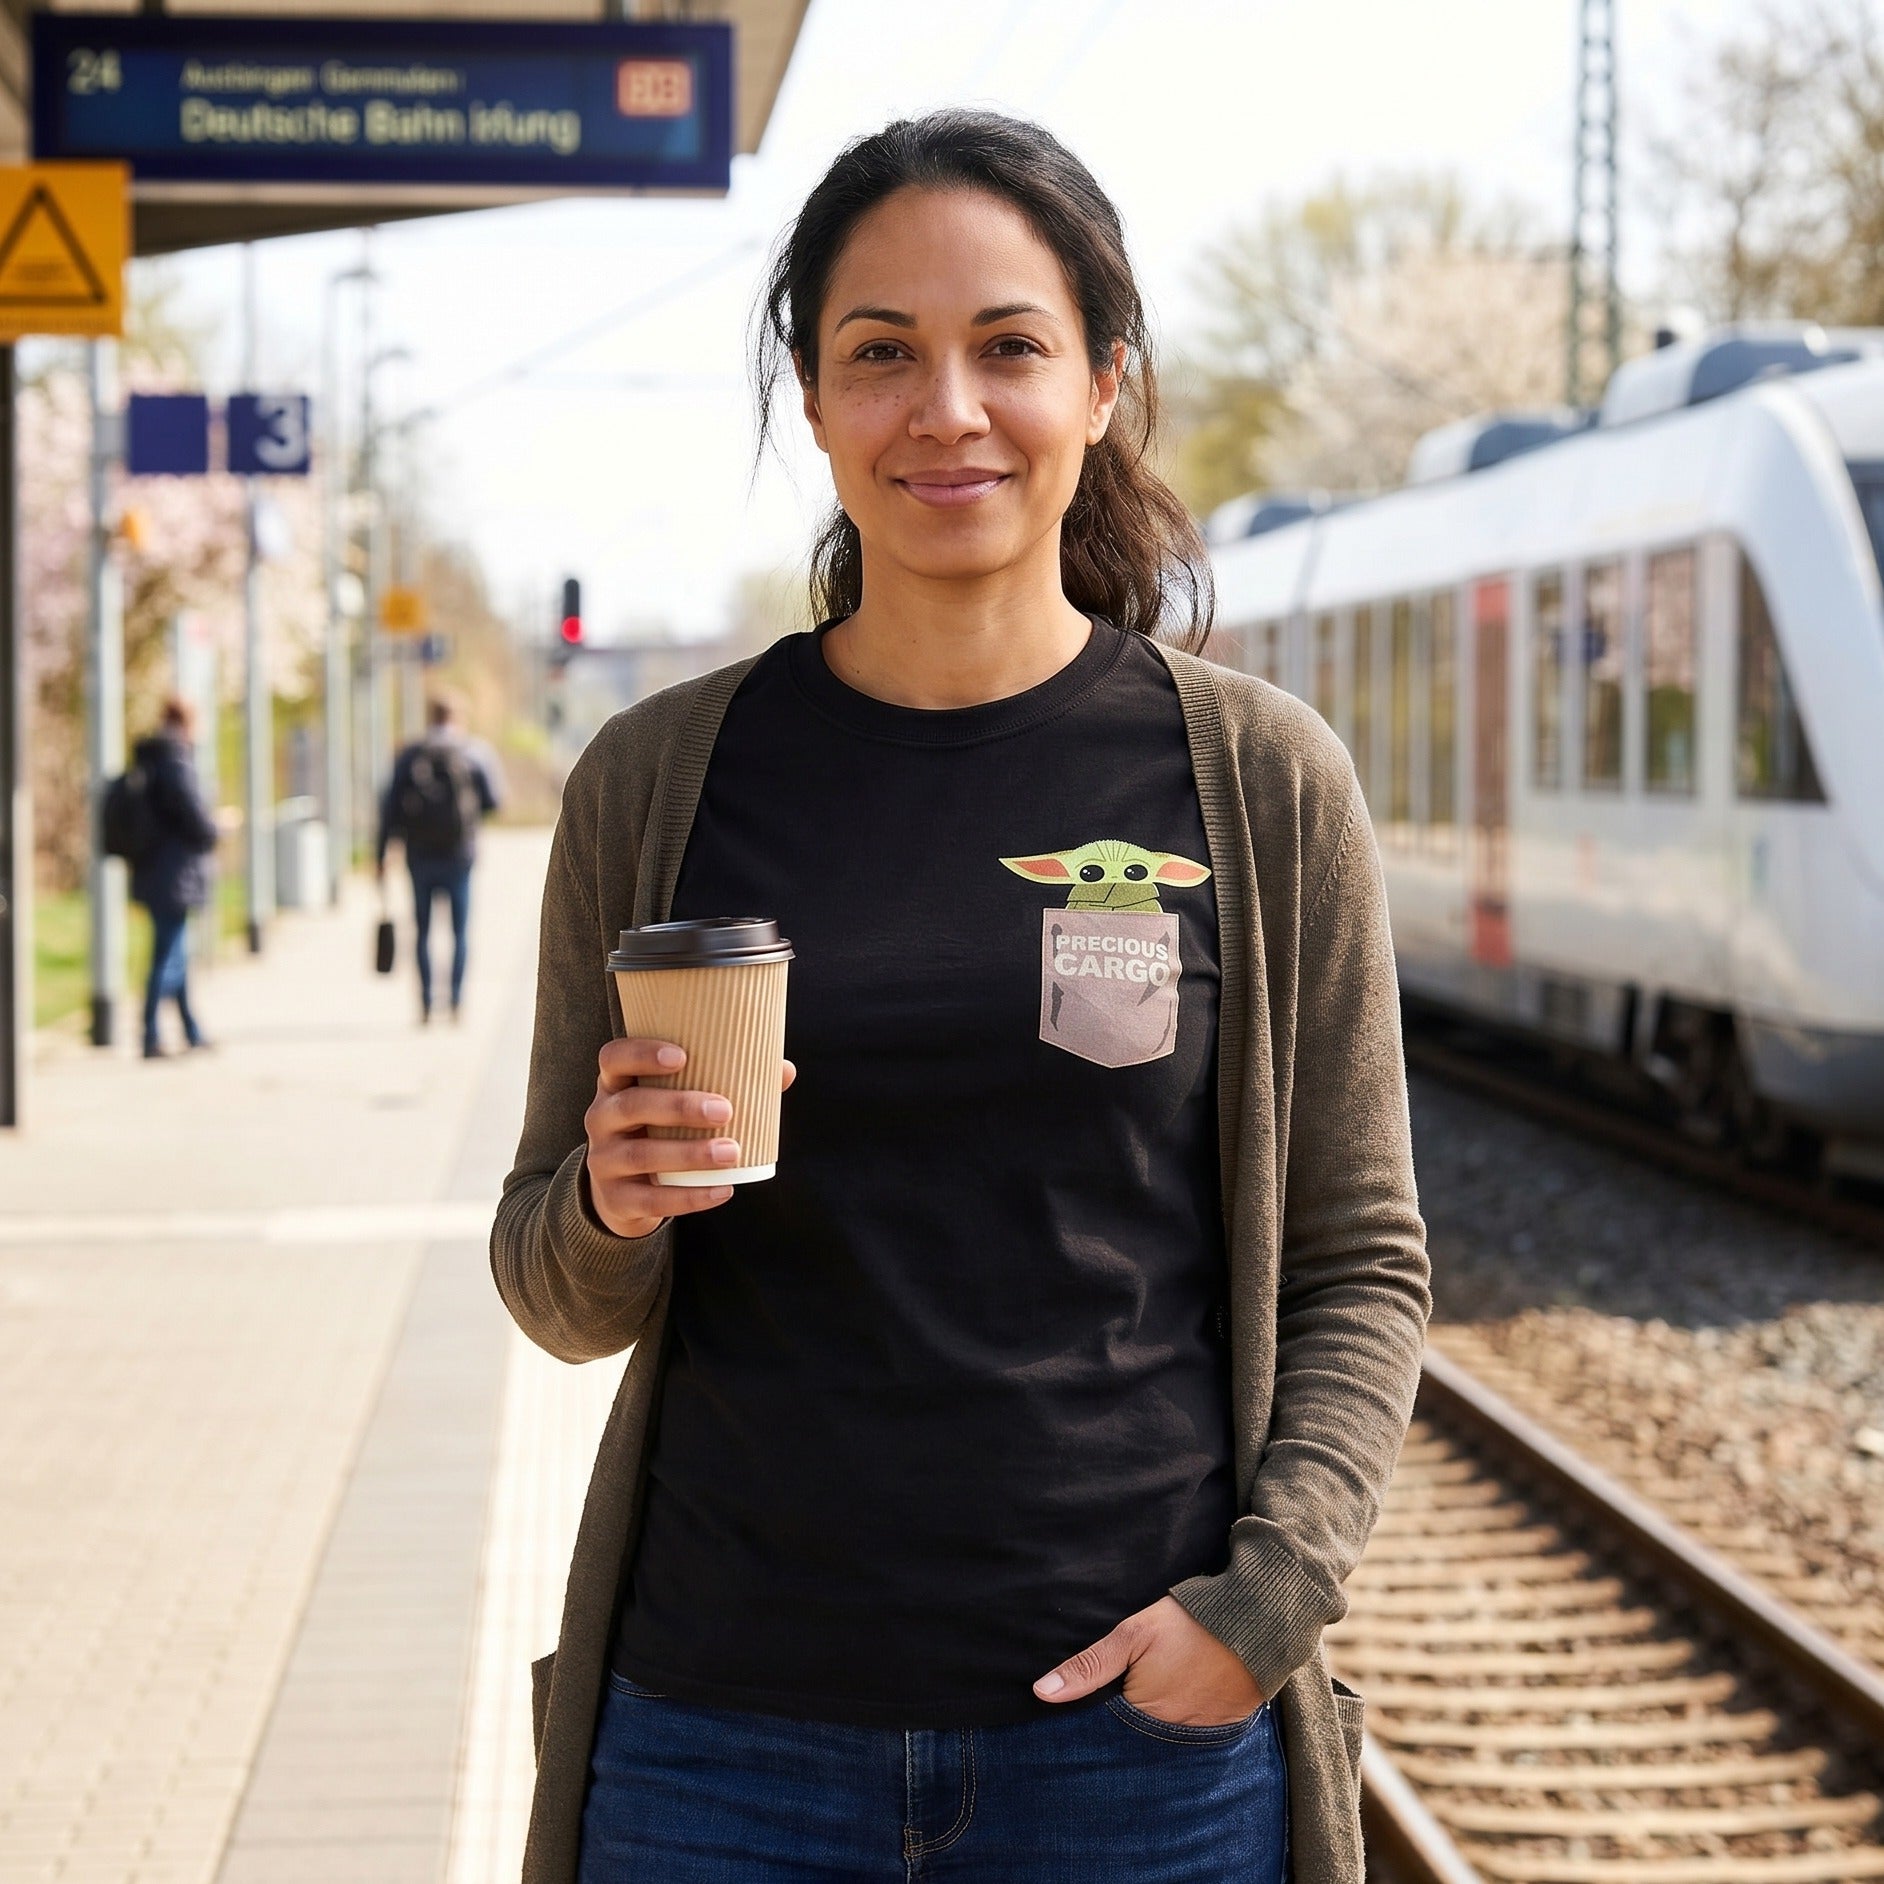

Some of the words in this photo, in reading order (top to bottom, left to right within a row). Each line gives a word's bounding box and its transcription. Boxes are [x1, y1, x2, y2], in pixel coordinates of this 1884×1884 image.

[181, 98, 359, 142] Deutsche
[365, 98, 465, 144] Bahn
[256, 394, 306, 469] 3
[1056, 934, 1168, 961] PRECIOUS
[1054, 953, 1170, 986] CARGO
